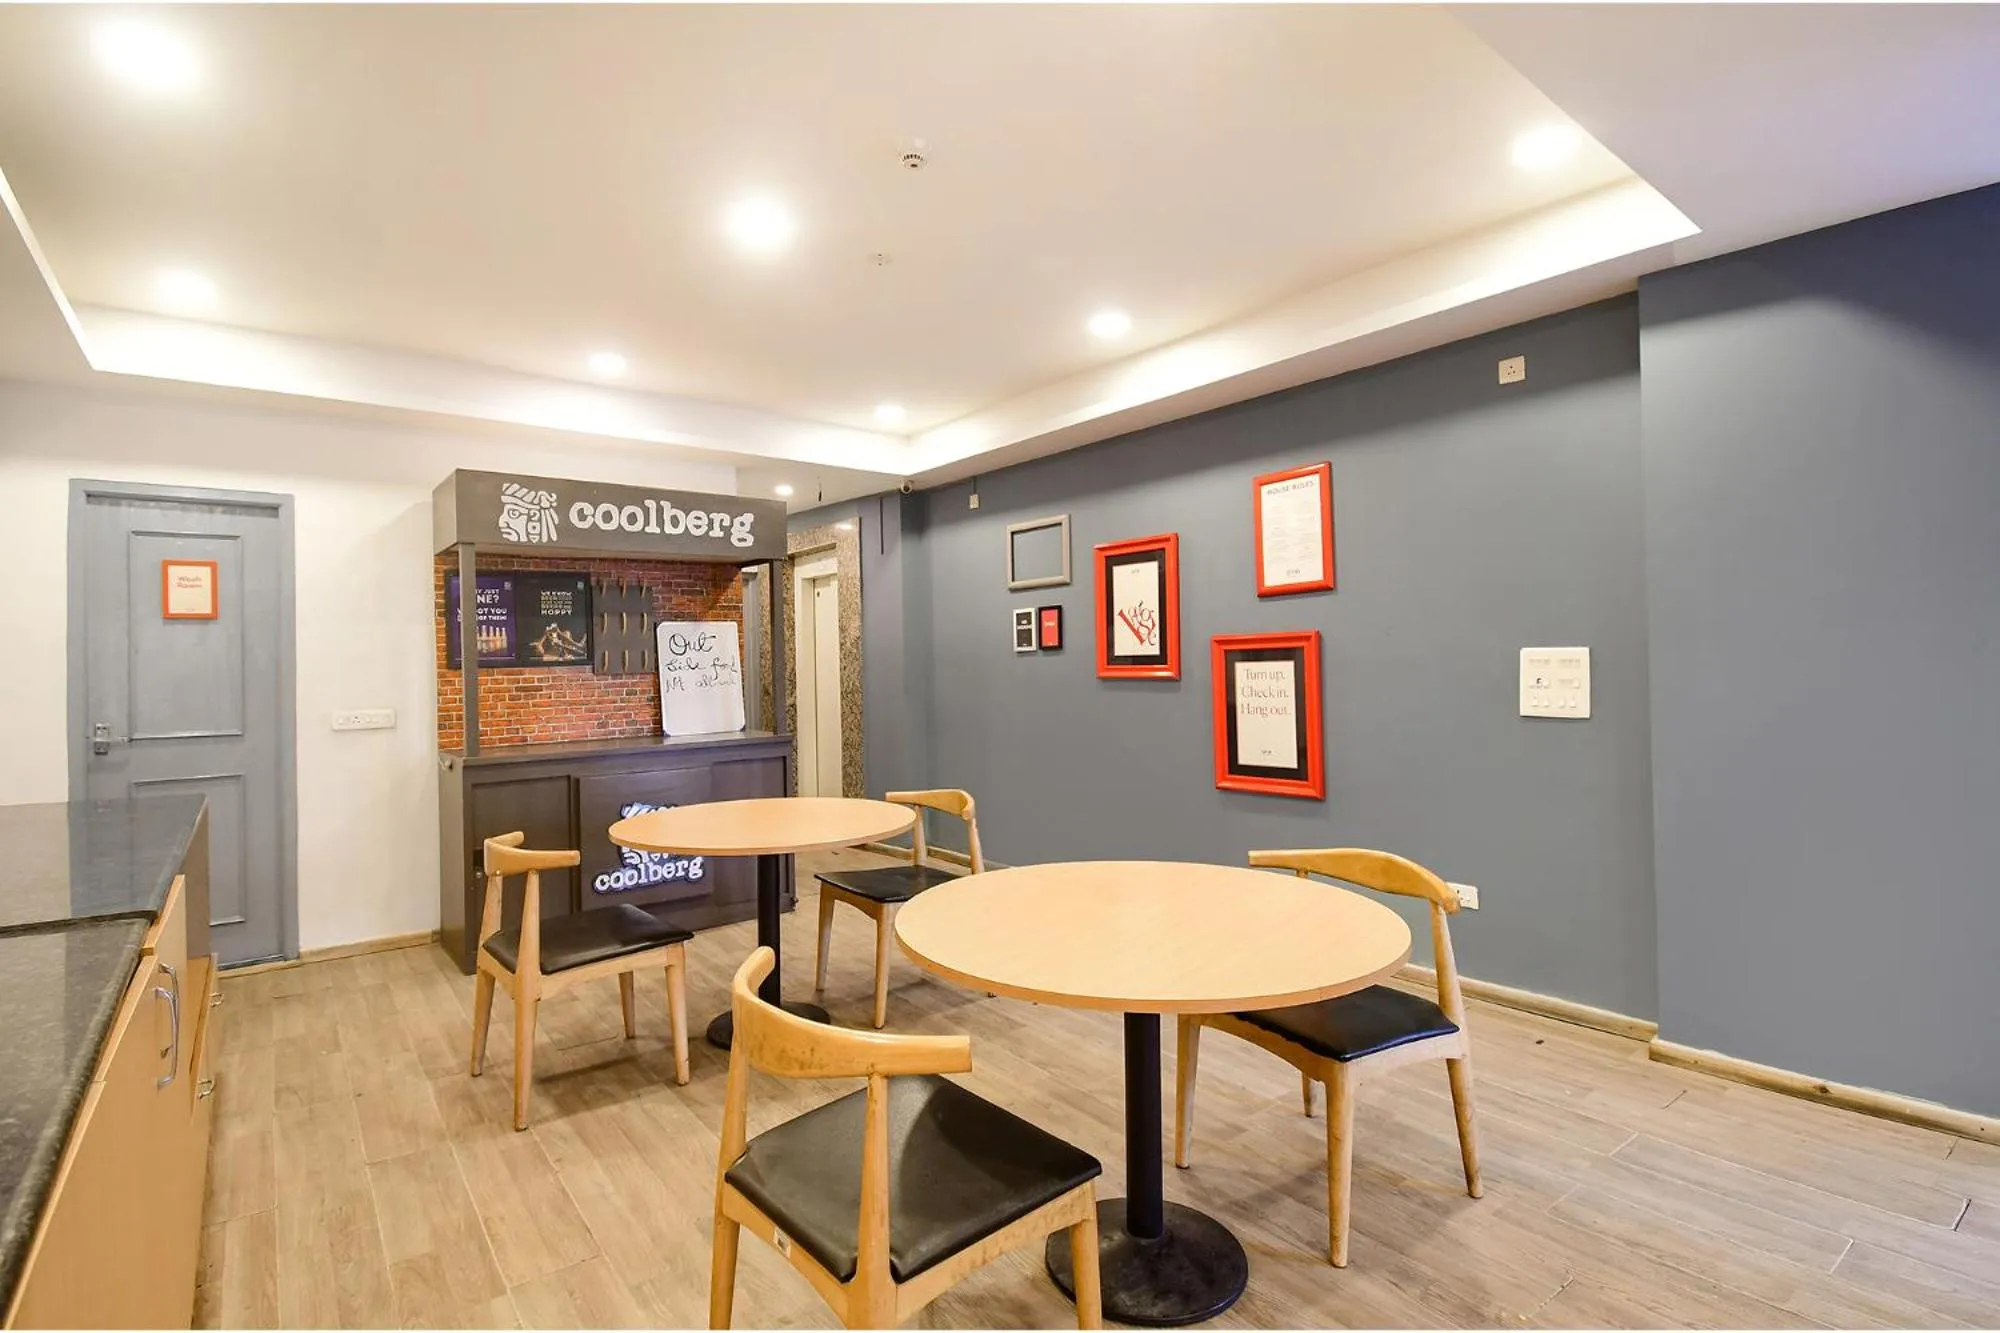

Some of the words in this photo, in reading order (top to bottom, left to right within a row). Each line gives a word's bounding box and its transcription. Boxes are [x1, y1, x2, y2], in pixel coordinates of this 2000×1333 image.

[568, 499, 755, 548] coolberg
[476, 594, 500, 604] NE?
[668, 631, 717, 656] Out
[1243, 668, 1267, 681] Turn
[1240, 684, 1275, 699] Check
[1240, 702, 1269, 718] Hang
[595, 856, 704, 891] coolberg
